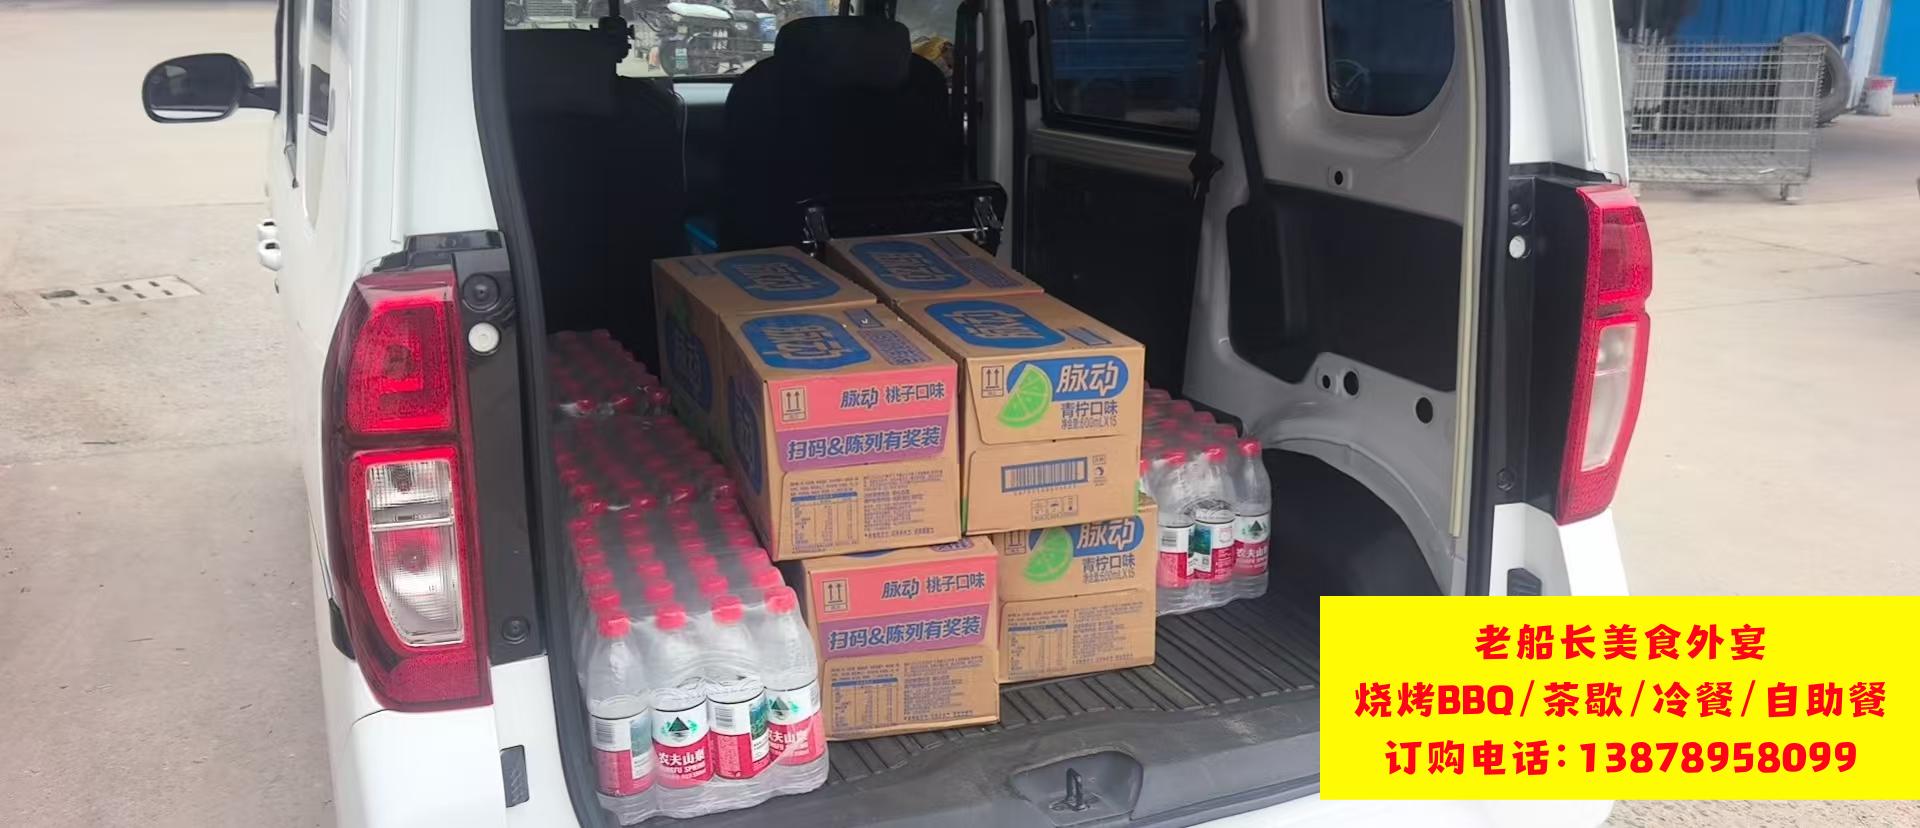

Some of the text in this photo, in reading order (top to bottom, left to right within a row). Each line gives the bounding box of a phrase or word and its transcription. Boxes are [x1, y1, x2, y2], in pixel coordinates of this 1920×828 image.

[1056, 360, 1119, 397] 脉动
[840, 382, 945, 410] 脉动 桃子口味
[1061, 400, 1118, 418] 青柠口味
[787, 426, 941, 461] 扫码&陈列有奖装
[1077, 519, 1135, 550] 脉动
[1083, 553, 1136, 573] 青柠口味
[881, 572, 985, 599] 脉动 桃子口味
[829, 615, 981, 650] 扫码&陈列有奖装
